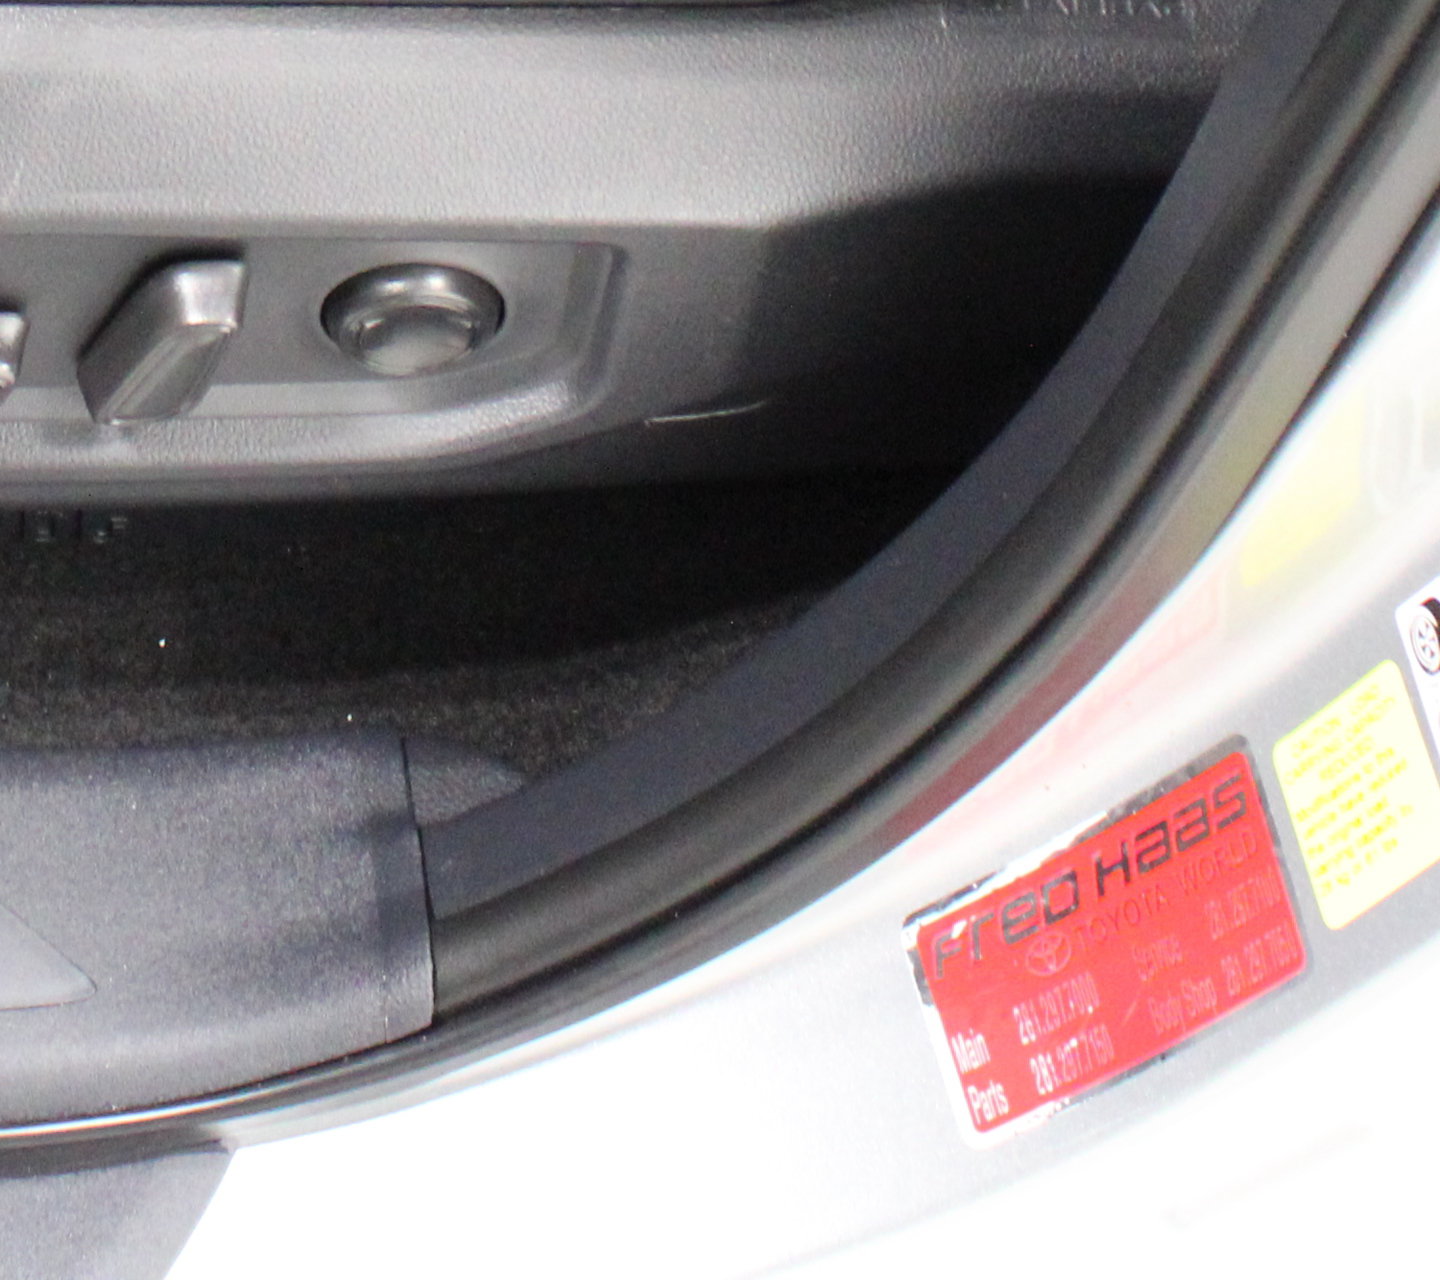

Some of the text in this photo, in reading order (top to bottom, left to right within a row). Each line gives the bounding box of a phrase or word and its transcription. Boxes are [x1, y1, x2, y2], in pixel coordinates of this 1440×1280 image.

[1076, 888, 1170, 950] TOYOTA
[1178, 827, 1259, 897] WORLD
[952, 1028, 991, 1073] Main
[967, 1079, 1009, 1126] Parts
